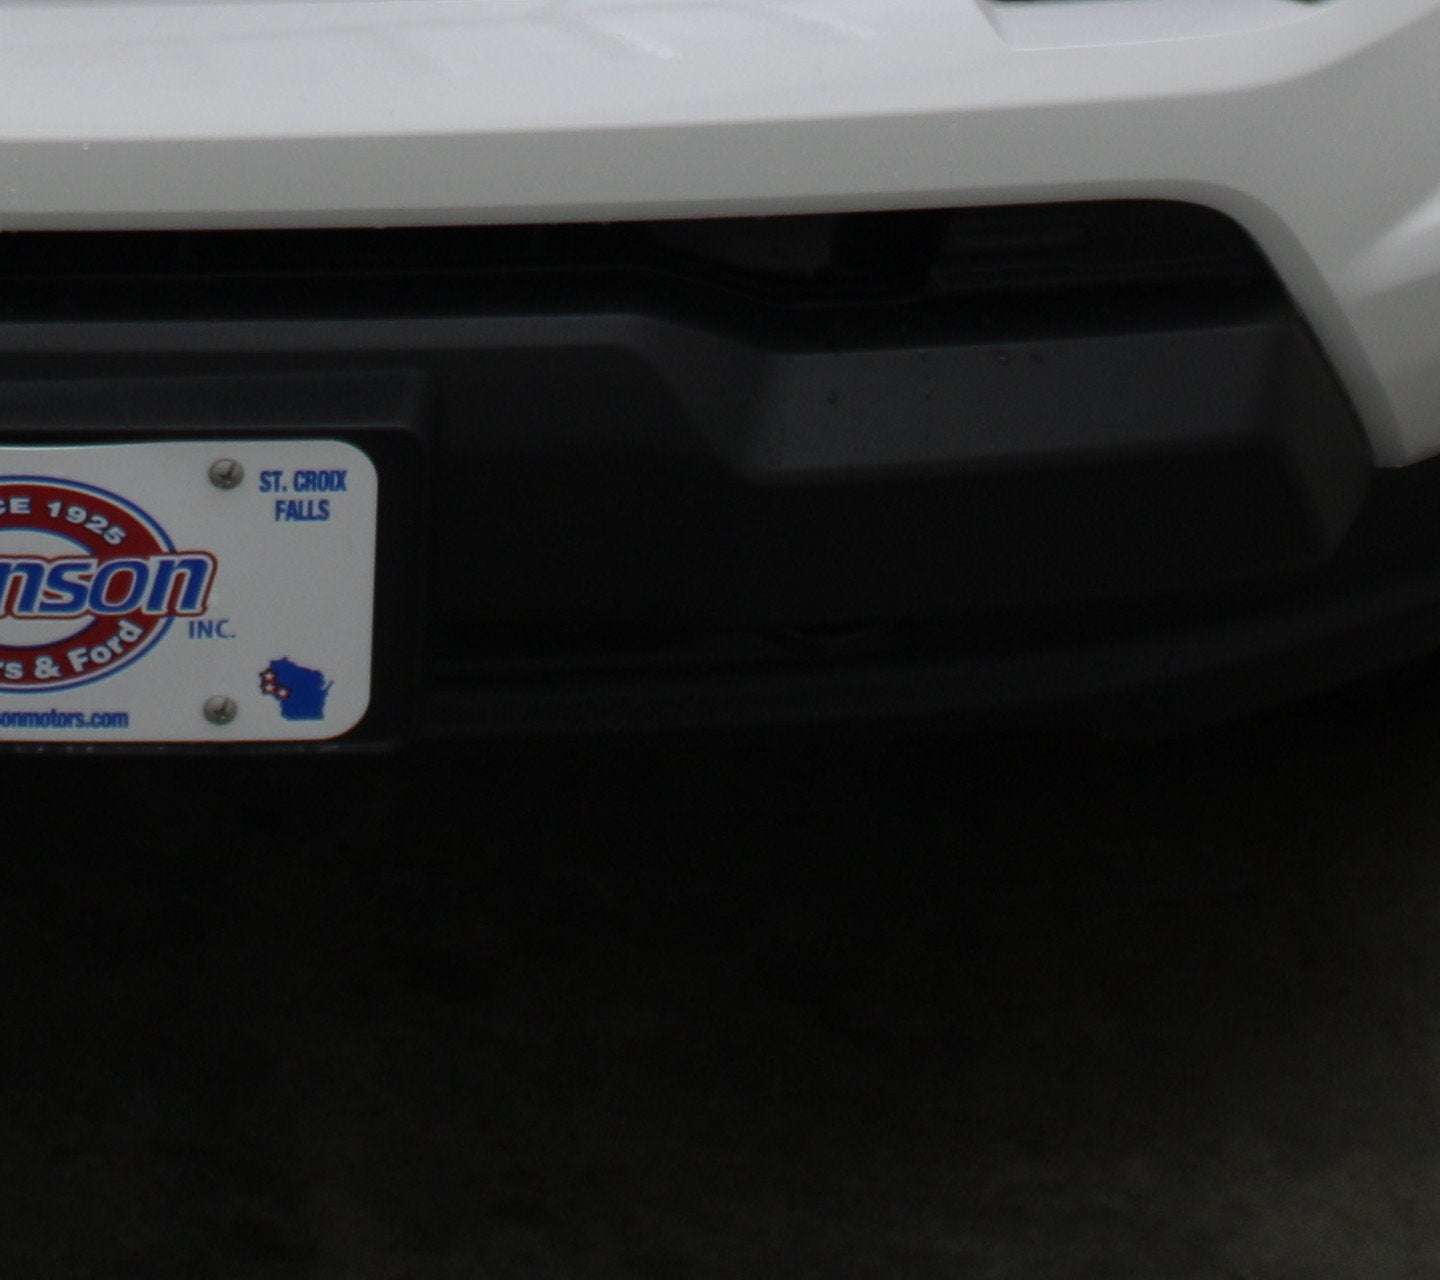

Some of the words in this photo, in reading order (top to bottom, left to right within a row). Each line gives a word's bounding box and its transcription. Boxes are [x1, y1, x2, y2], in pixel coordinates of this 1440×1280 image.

[259, 471, 288, 492] ST.
[293, 470, 348, 492] CROIX
[275, 500, 330, 522] FALLS
[47, 501, 126, 545] 1925
[188, 619, 237, 639] INC.
[34, 656, 63, 679] &
[67, 620, 143, 673] Ford
